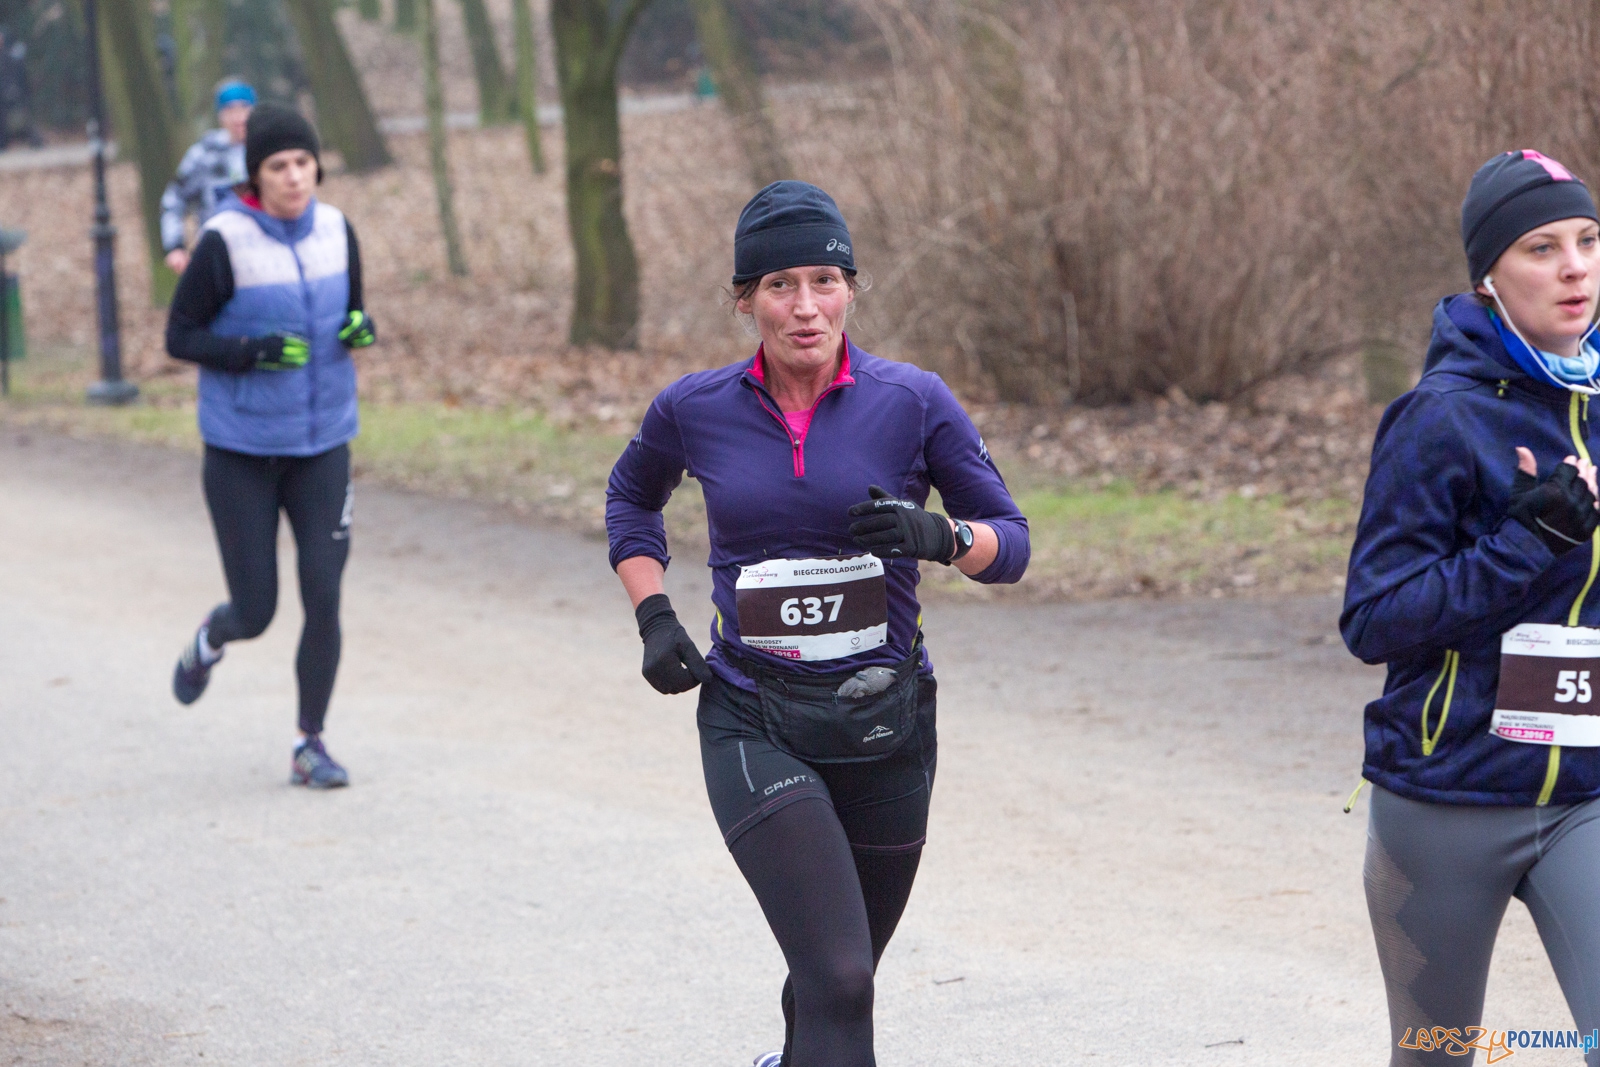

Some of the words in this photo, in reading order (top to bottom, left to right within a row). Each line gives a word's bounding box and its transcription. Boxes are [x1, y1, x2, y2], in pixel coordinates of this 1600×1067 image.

[793, 562, 878, 576] BIEGCZEKOLADOWY.PL
[780, 594, 845, 626] 637
[1554, 670, 1593, 703] 55
[764, 775, 806, 795] CRAFT
